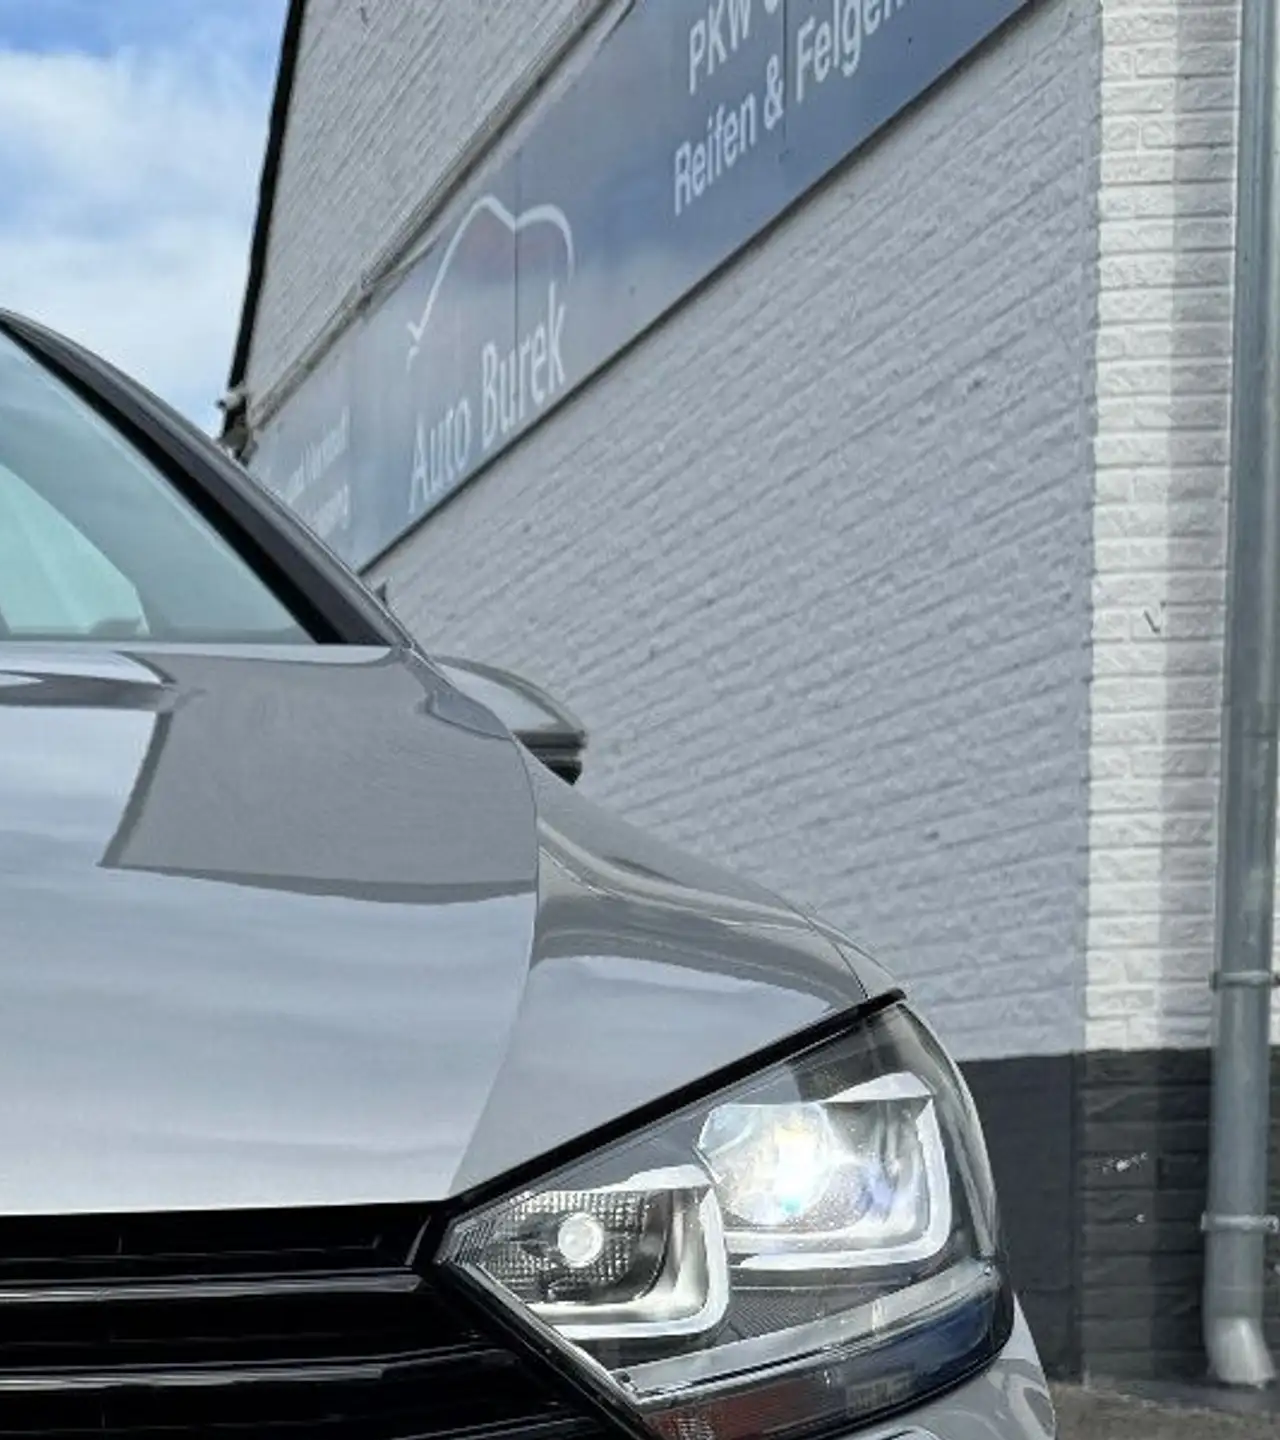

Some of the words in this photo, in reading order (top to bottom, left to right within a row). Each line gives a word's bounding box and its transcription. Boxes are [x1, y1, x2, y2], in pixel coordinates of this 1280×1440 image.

[674, 92, 756, 216] Reifen
[763, 54, 784, 130] &
[796, 0, 904, 103] Felge
[689, 0, 751, 96] PKW
[407, 397, 472, 514] Auto
[482, 280, 566, 450] Burek
